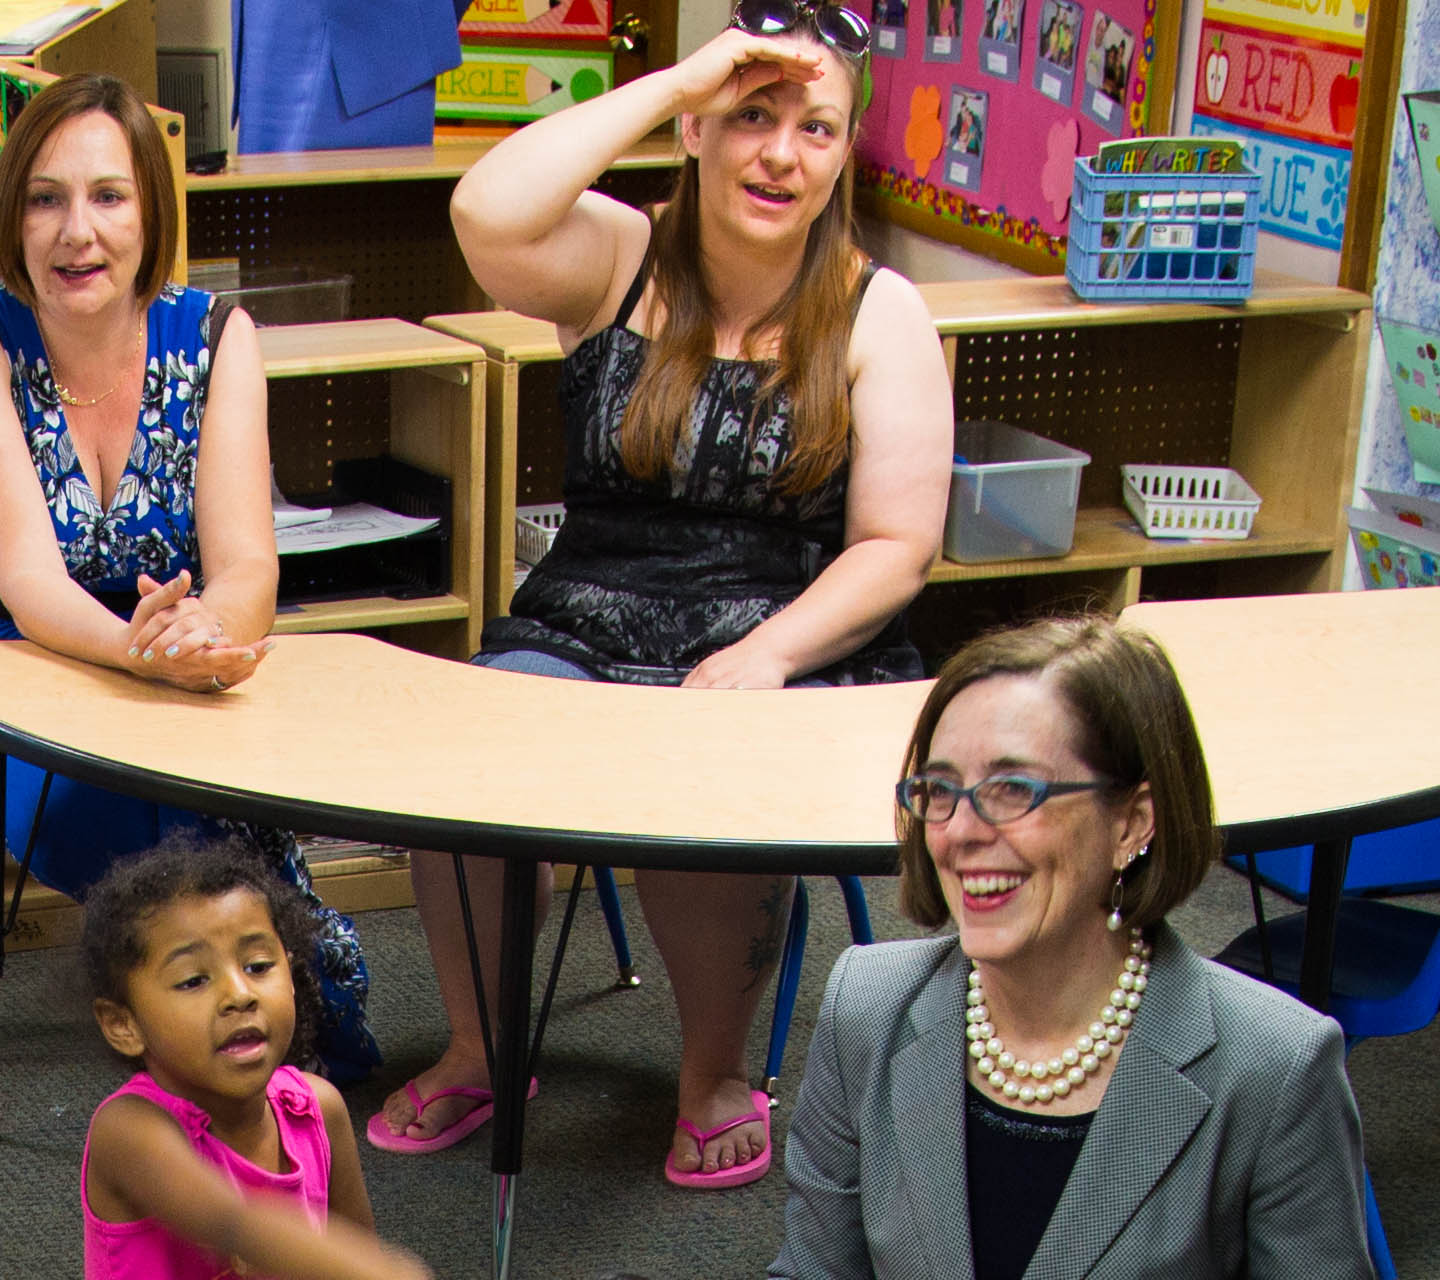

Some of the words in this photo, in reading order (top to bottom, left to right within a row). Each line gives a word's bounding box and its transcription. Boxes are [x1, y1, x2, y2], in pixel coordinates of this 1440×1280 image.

[438, 69, 521, 97] IRCLE
[1239, 43, 1315, 123] RED
[1106, 150, 1150, 173] WHY
[1153, 147, 1235, 173] WRITE?
